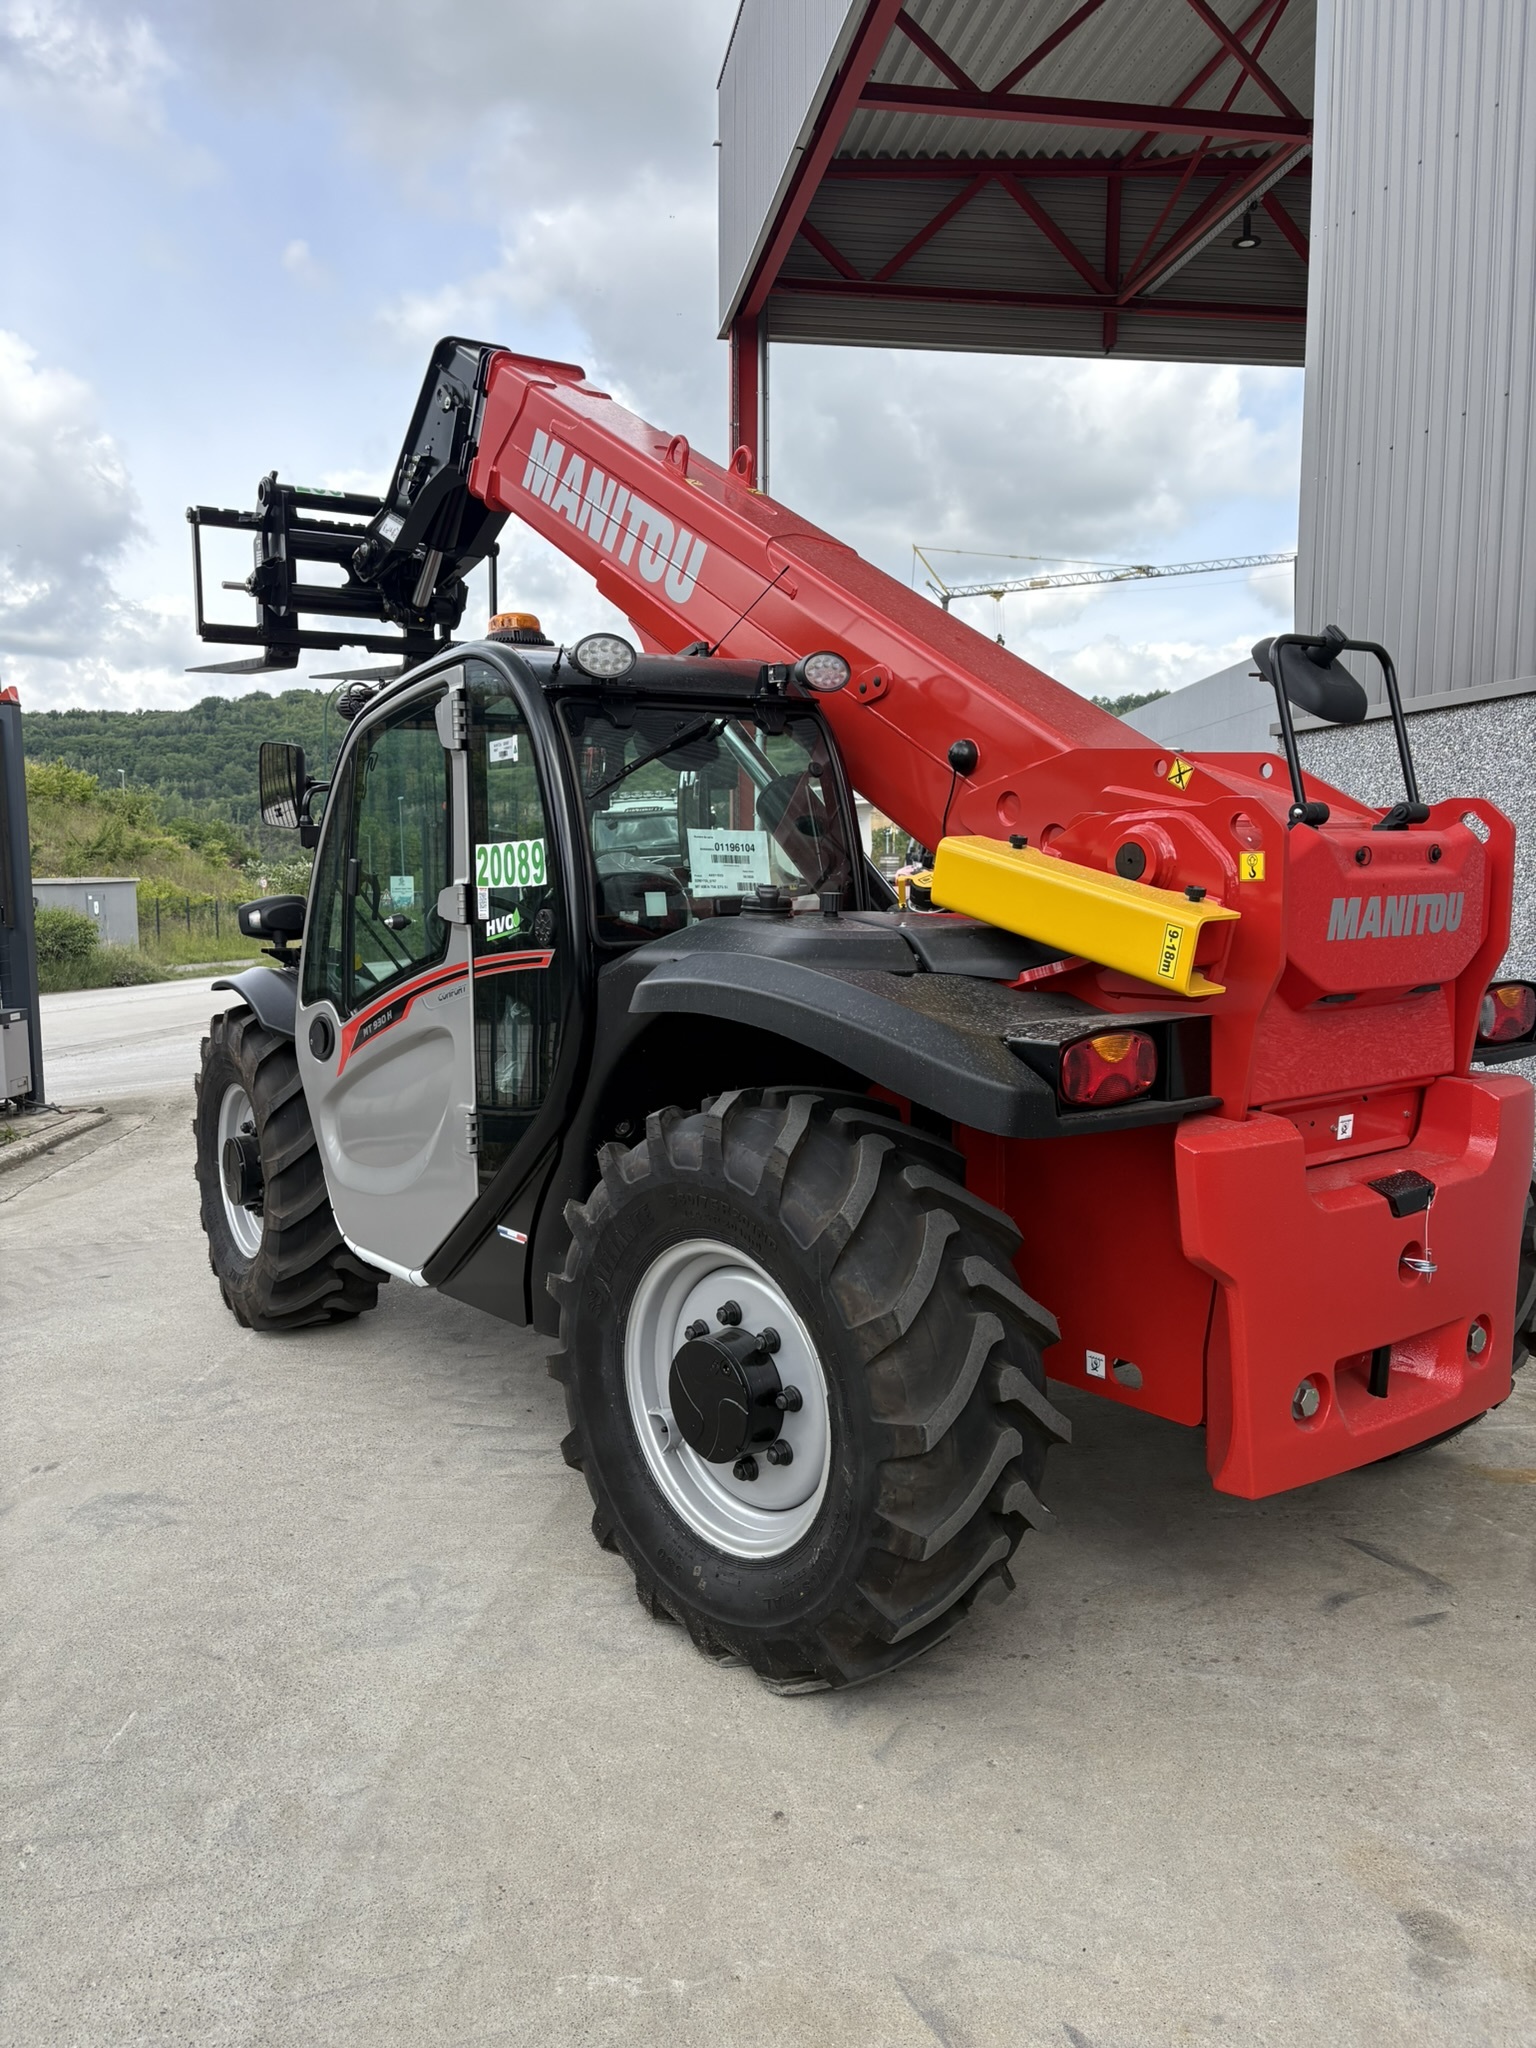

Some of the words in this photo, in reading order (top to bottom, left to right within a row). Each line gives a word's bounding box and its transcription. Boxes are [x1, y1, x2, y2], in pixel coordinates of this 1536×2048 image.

[521, 427, 708, 604] MANITOU
[477, 841, 545, 887] 20089
[714, 842, 755, 852] 01196104
[1326, 891, 1465, 942] MANITOU
[1161, 930, 1180, 973] 9-18m
[363, 1026, 373, 1038] MT
[372, 1015, 387, 1028] 930
[386, 1009, 393, 1021] H
